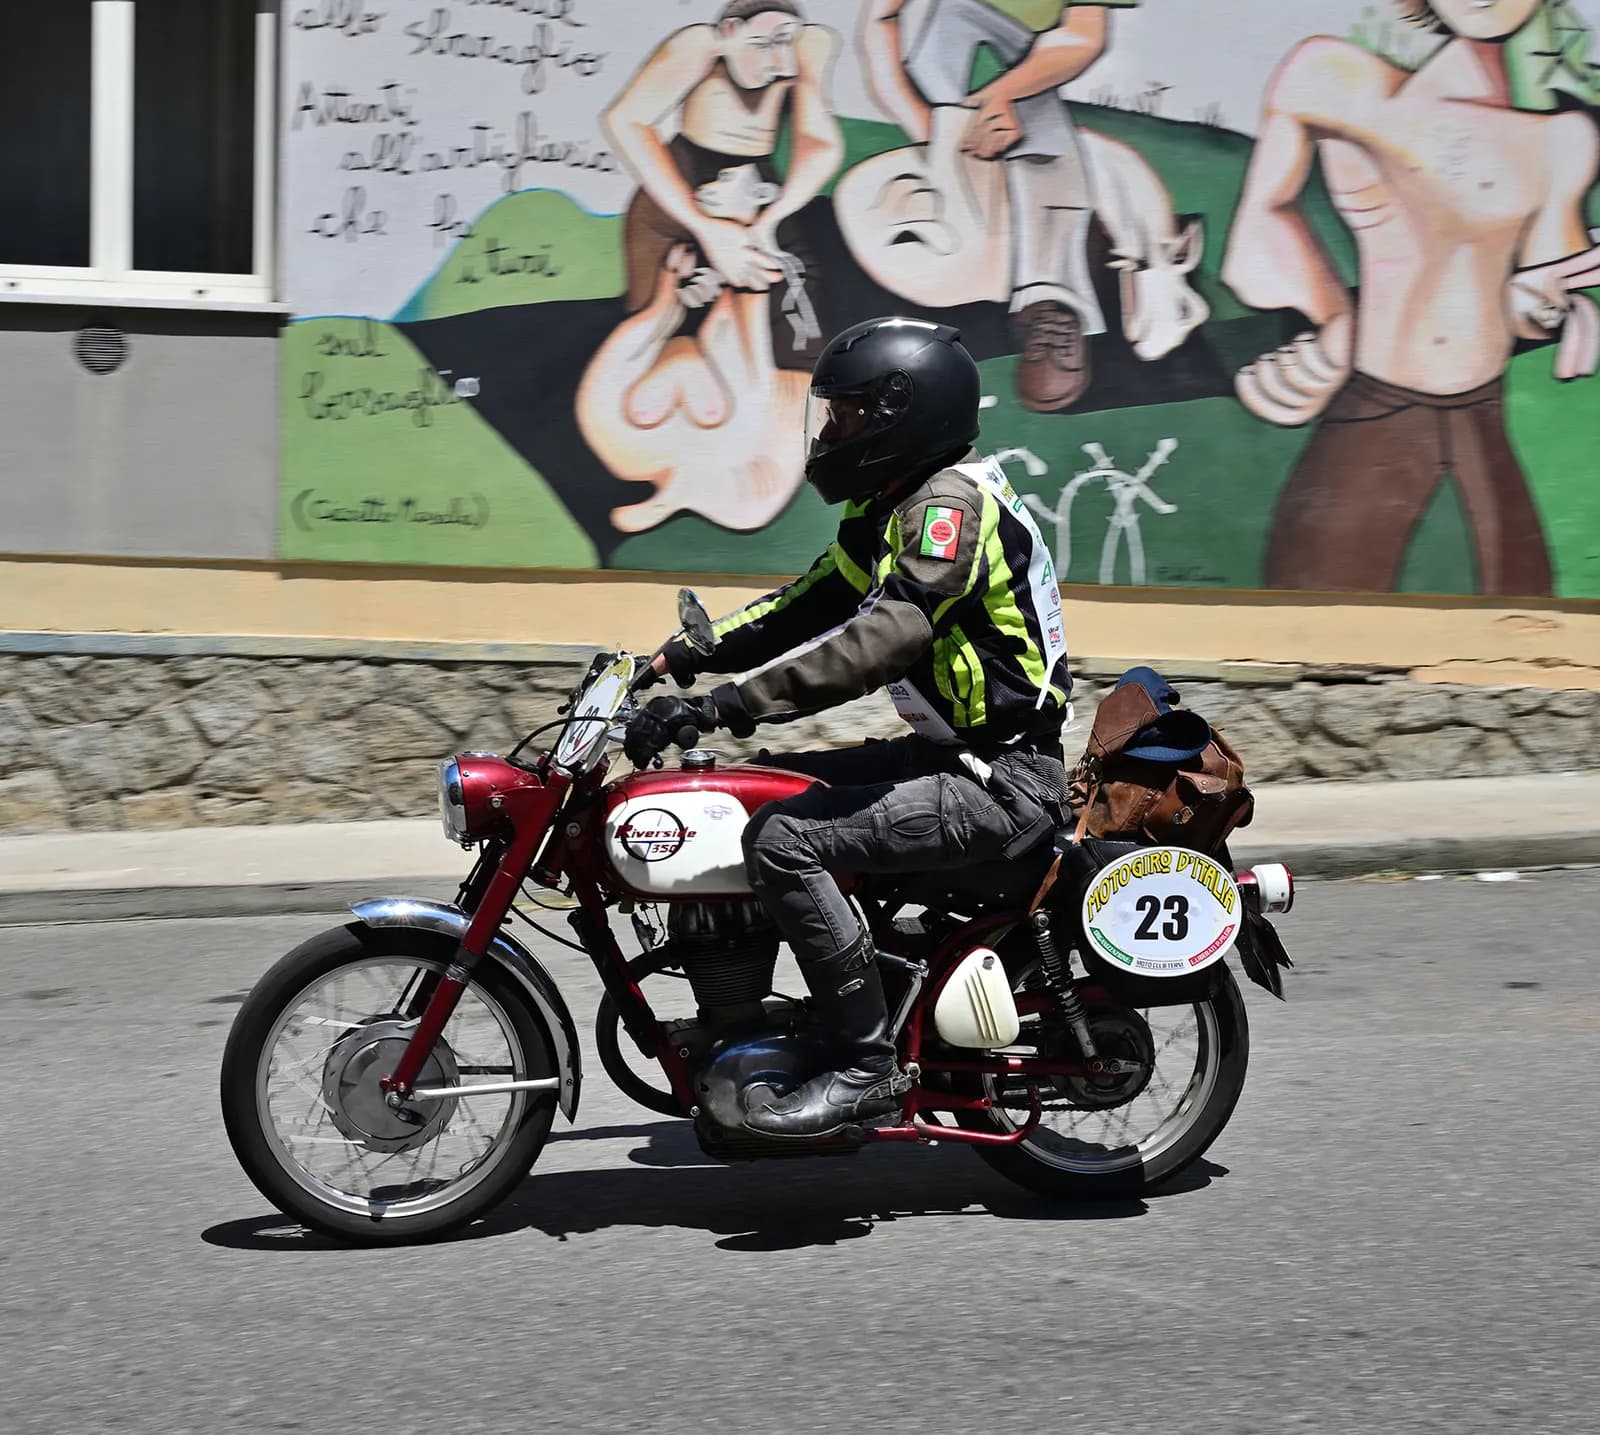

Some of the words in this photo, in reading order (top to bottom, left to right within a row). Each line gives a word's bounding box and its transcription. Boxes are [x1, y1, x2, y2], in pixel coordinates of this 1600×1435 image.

[614, 824, 697, 839] Riverside
[652, 844, 679, 854] 350
[1176, 851, 1236, 914] D'ITALIA
[1134, 895, 1189, 940] 23
